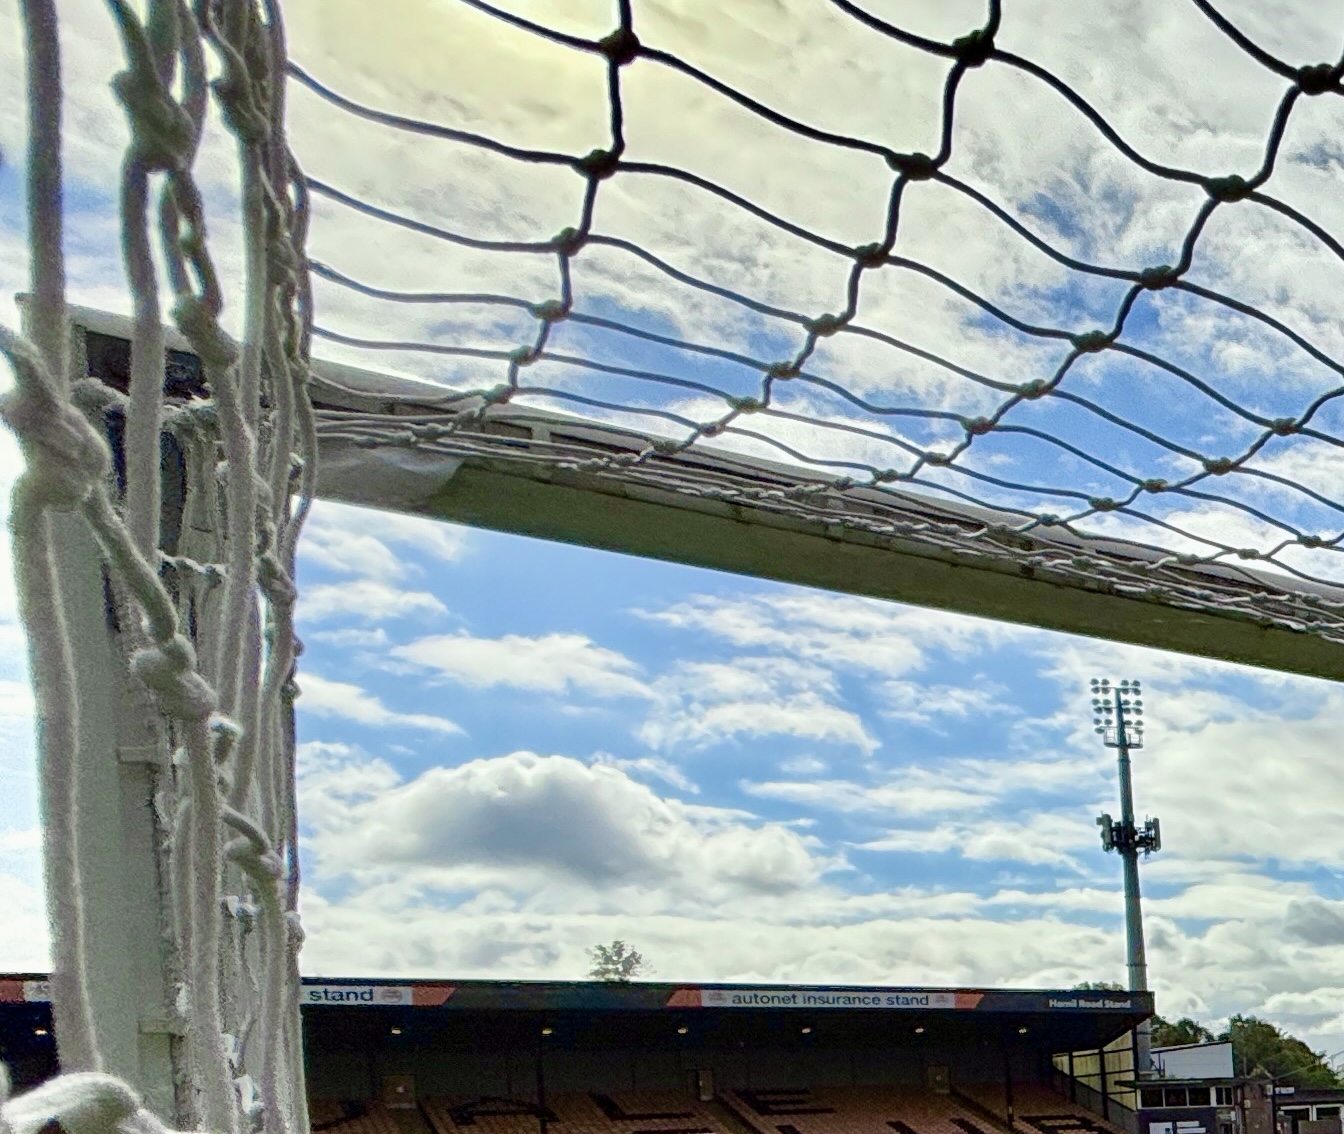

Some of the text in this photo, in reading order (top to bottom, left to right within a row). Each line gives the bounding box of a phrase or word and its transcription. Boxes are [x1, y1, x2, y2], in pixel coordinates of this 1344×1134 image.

[309, 987, 374, 1002] stand
[732, 993, 929, 1006] autonet insurance stand
[1103, 1000, 1131, 1009] Stand
